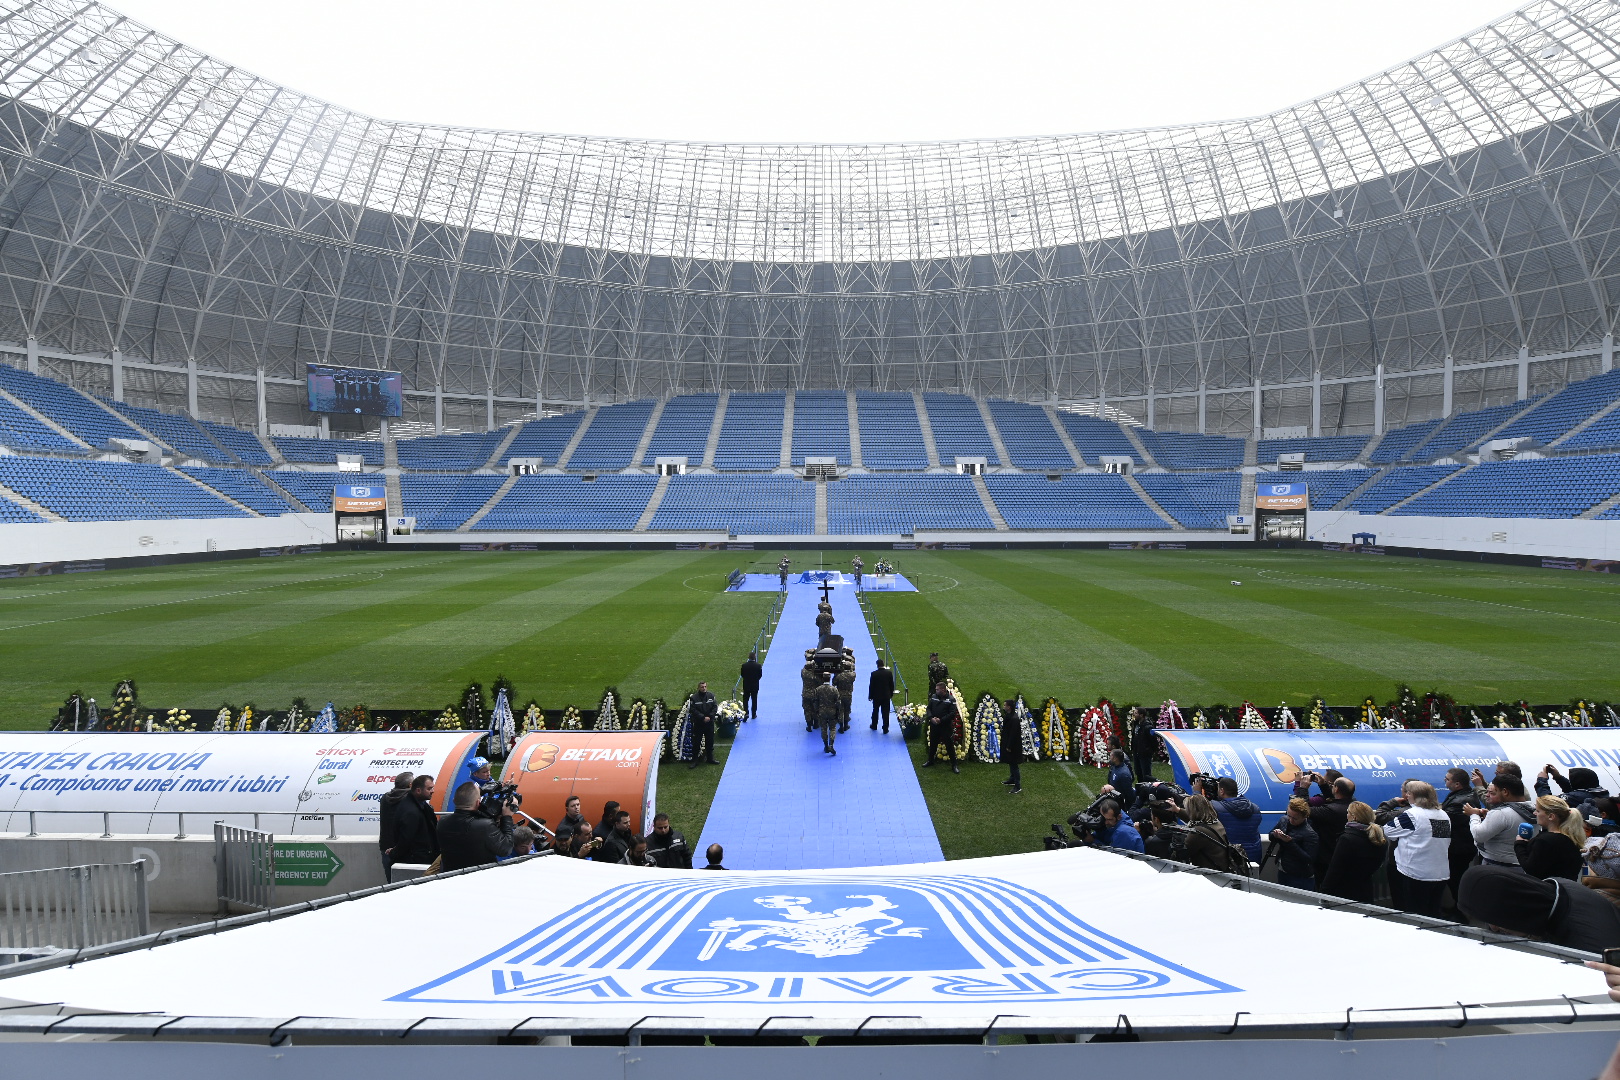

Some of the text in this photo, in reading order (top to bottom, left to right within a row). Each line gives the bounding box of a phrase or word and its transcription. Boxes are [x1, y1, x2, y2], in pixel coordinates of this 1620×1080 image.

[315, 748, 370, 756] STICKY
[560, 747, 642, 761] BETANO
[86, 751, 213, 771] CRAIOVA
[318, 759, 353, 770] Coral
[1299, 754, 1387, 770] BETANO
[1396, 756, 1500, 767] Partener principal
[20, 774, 134, 796] Campioana
[133, 775, 182, 792] unei
[185, 775, 233, 793] mari
[229, 776, 290, 793] iubiri
[285, 850, 295, 858] DE
[296, 850, 328, 859] URGENTA
[265, 871, 329, 879] EERGENCY EXIT
[491, 967, 1172, 999] CRAIOVA
